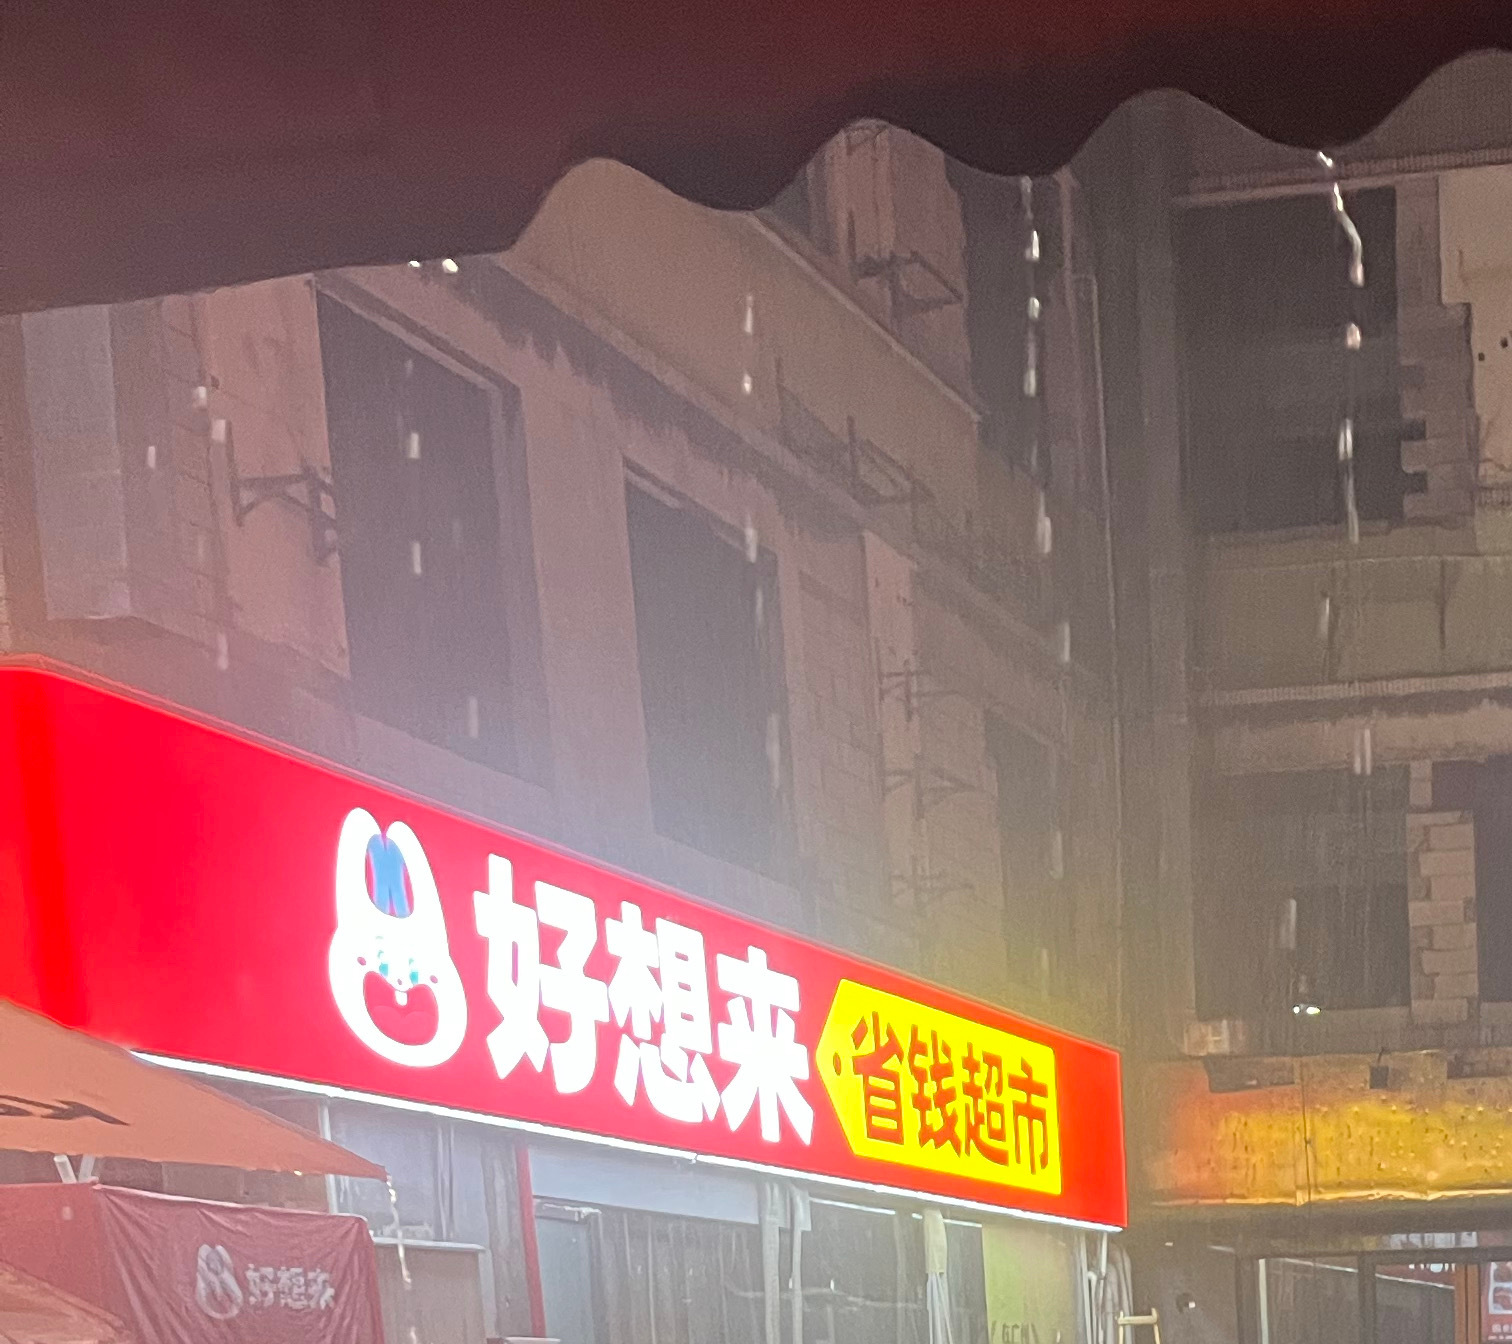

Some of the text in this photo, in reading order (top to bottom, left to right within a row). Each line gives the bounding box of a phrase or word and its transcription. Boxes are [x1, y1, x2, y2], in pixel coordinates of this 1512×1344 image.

[472, 852, 815, 1146] 好想来
[851, 1010, 1049, 1175] 省钱超市
[244, 1264, 335, 1310] 好想来
